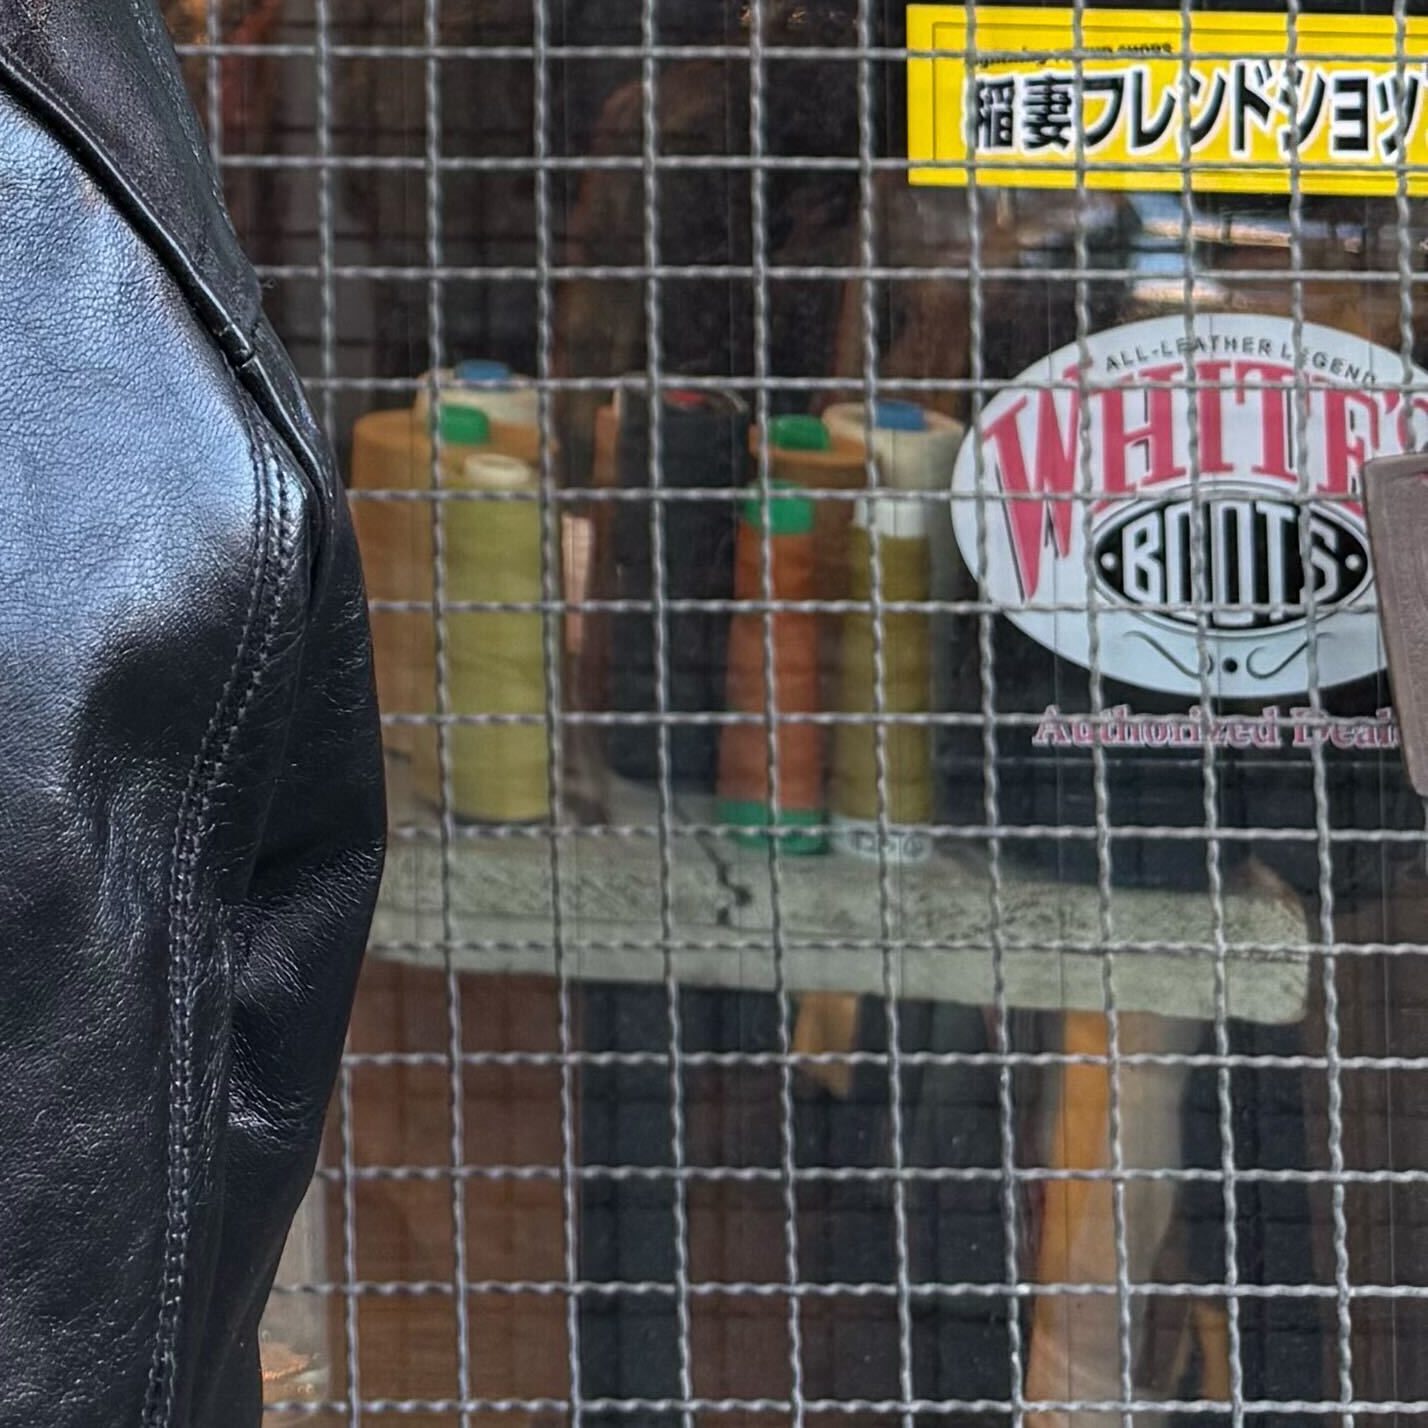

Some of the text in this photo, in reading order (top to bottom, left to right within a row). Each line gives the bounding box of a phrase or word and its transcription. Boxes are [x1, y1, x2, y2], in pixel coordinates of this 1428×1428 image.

[966, 58, 1428, 158] 稲妻フレンドショッ
[1122, 499, 1339, 626] BOOTS
[1032, 704, 1402, 750] Authorized Deal
